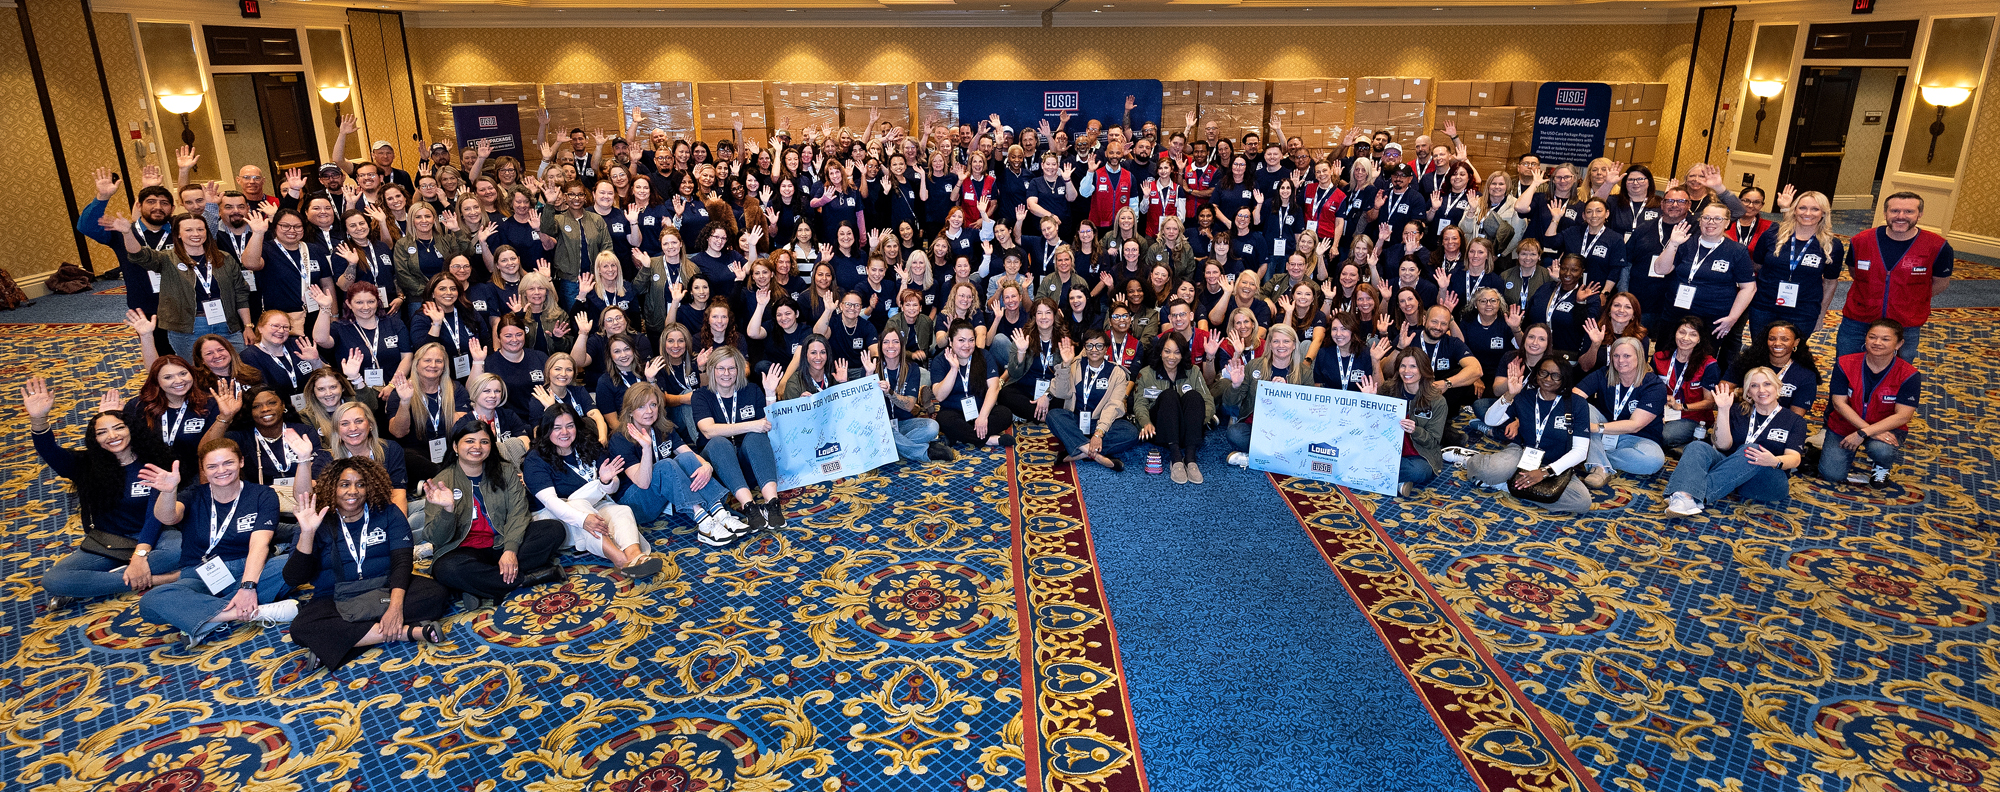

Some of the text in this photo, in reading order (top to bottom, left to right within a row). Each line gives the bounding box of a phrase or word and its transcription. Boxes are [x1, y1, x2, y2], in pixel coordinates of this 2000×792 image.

[245, 1, 257, 13] EXIT
[1856, 0, 1869, 9] EXIT
[1052, 95, 1071, 107] USO
[1563, 91, 1580, 103] USO
[1538, 116, 1600, 127] CARE PACKAGES
[771, 382, 874, 419] THANK YOU FOR YOUR SERVICE
[1264, 388, 1397, 412] THANK YOU FOR YOUR SERVICE
[818, 445, 839, 456] LOWE'S
[1311, 445, 1336, 456] LOWE'S
